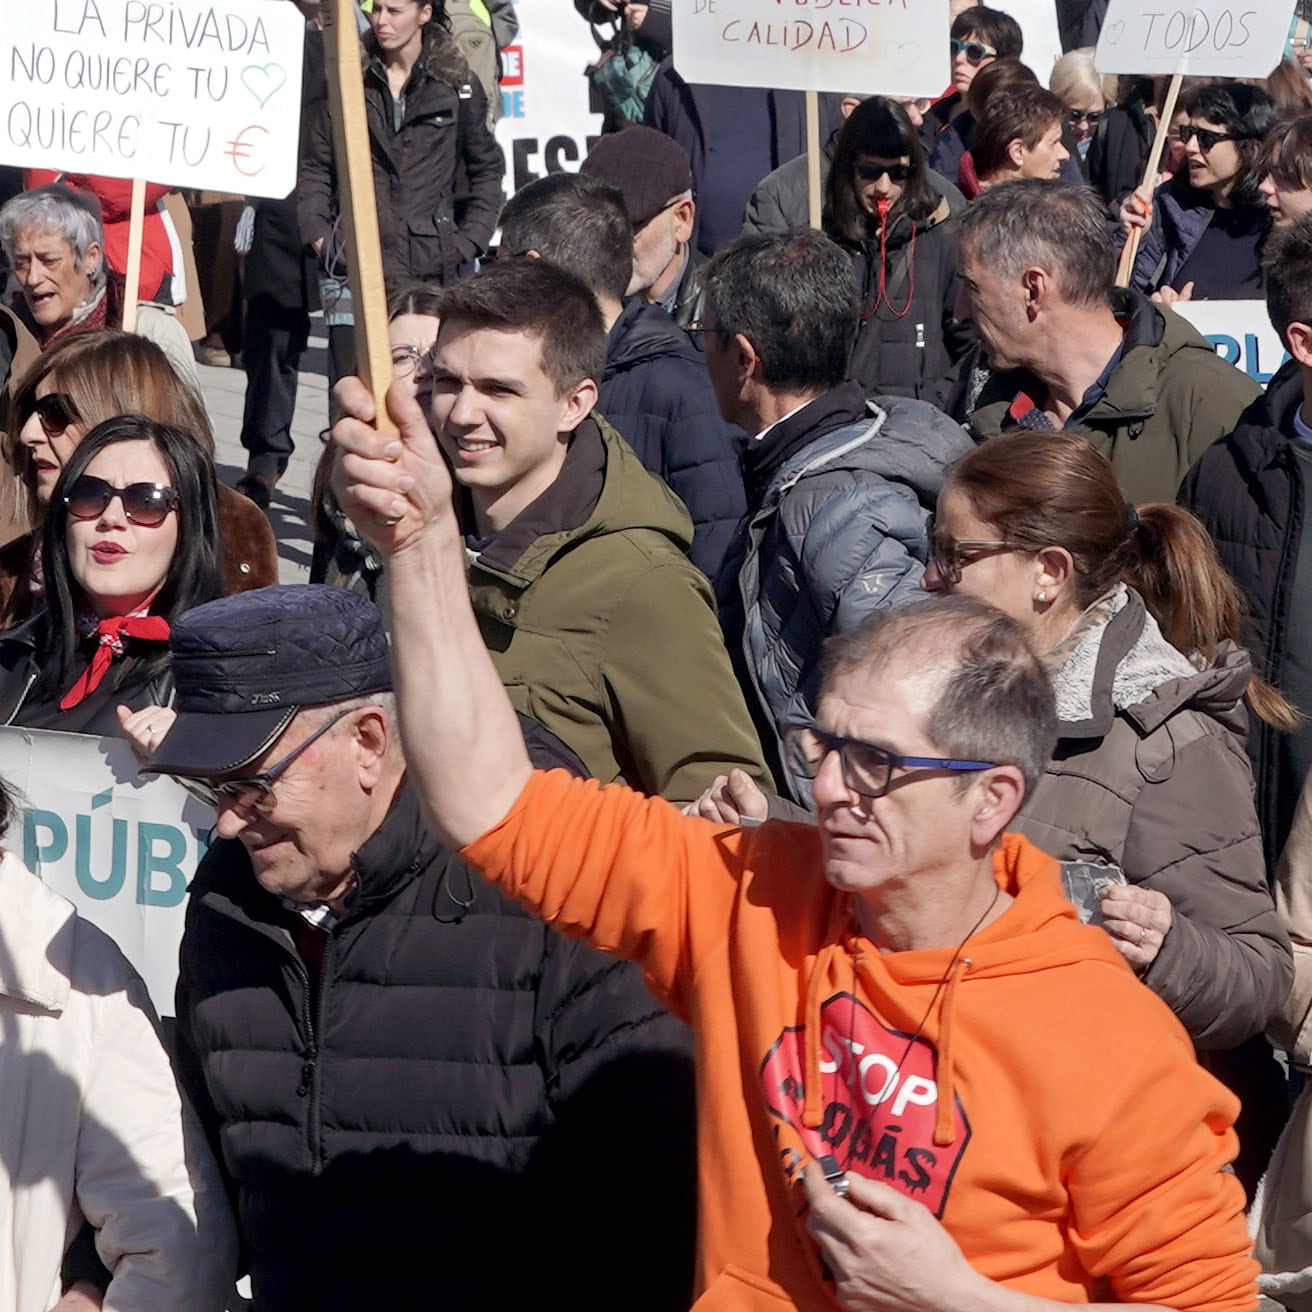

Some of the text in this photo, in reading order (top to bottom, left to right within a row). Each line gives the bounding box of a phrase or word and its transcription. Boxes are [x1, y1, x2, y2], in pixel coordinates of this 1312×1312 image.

[722, 18, 868, 53] CALIDAD
[1142, 7, 1257, 53] TODOS
[10, 43, 229, 101] NO QUIERE TU
[6, 101, 138, 161] QUIERE
[158, 117, 211, 167] TU
[21, 785, 209, 910] PÚB
